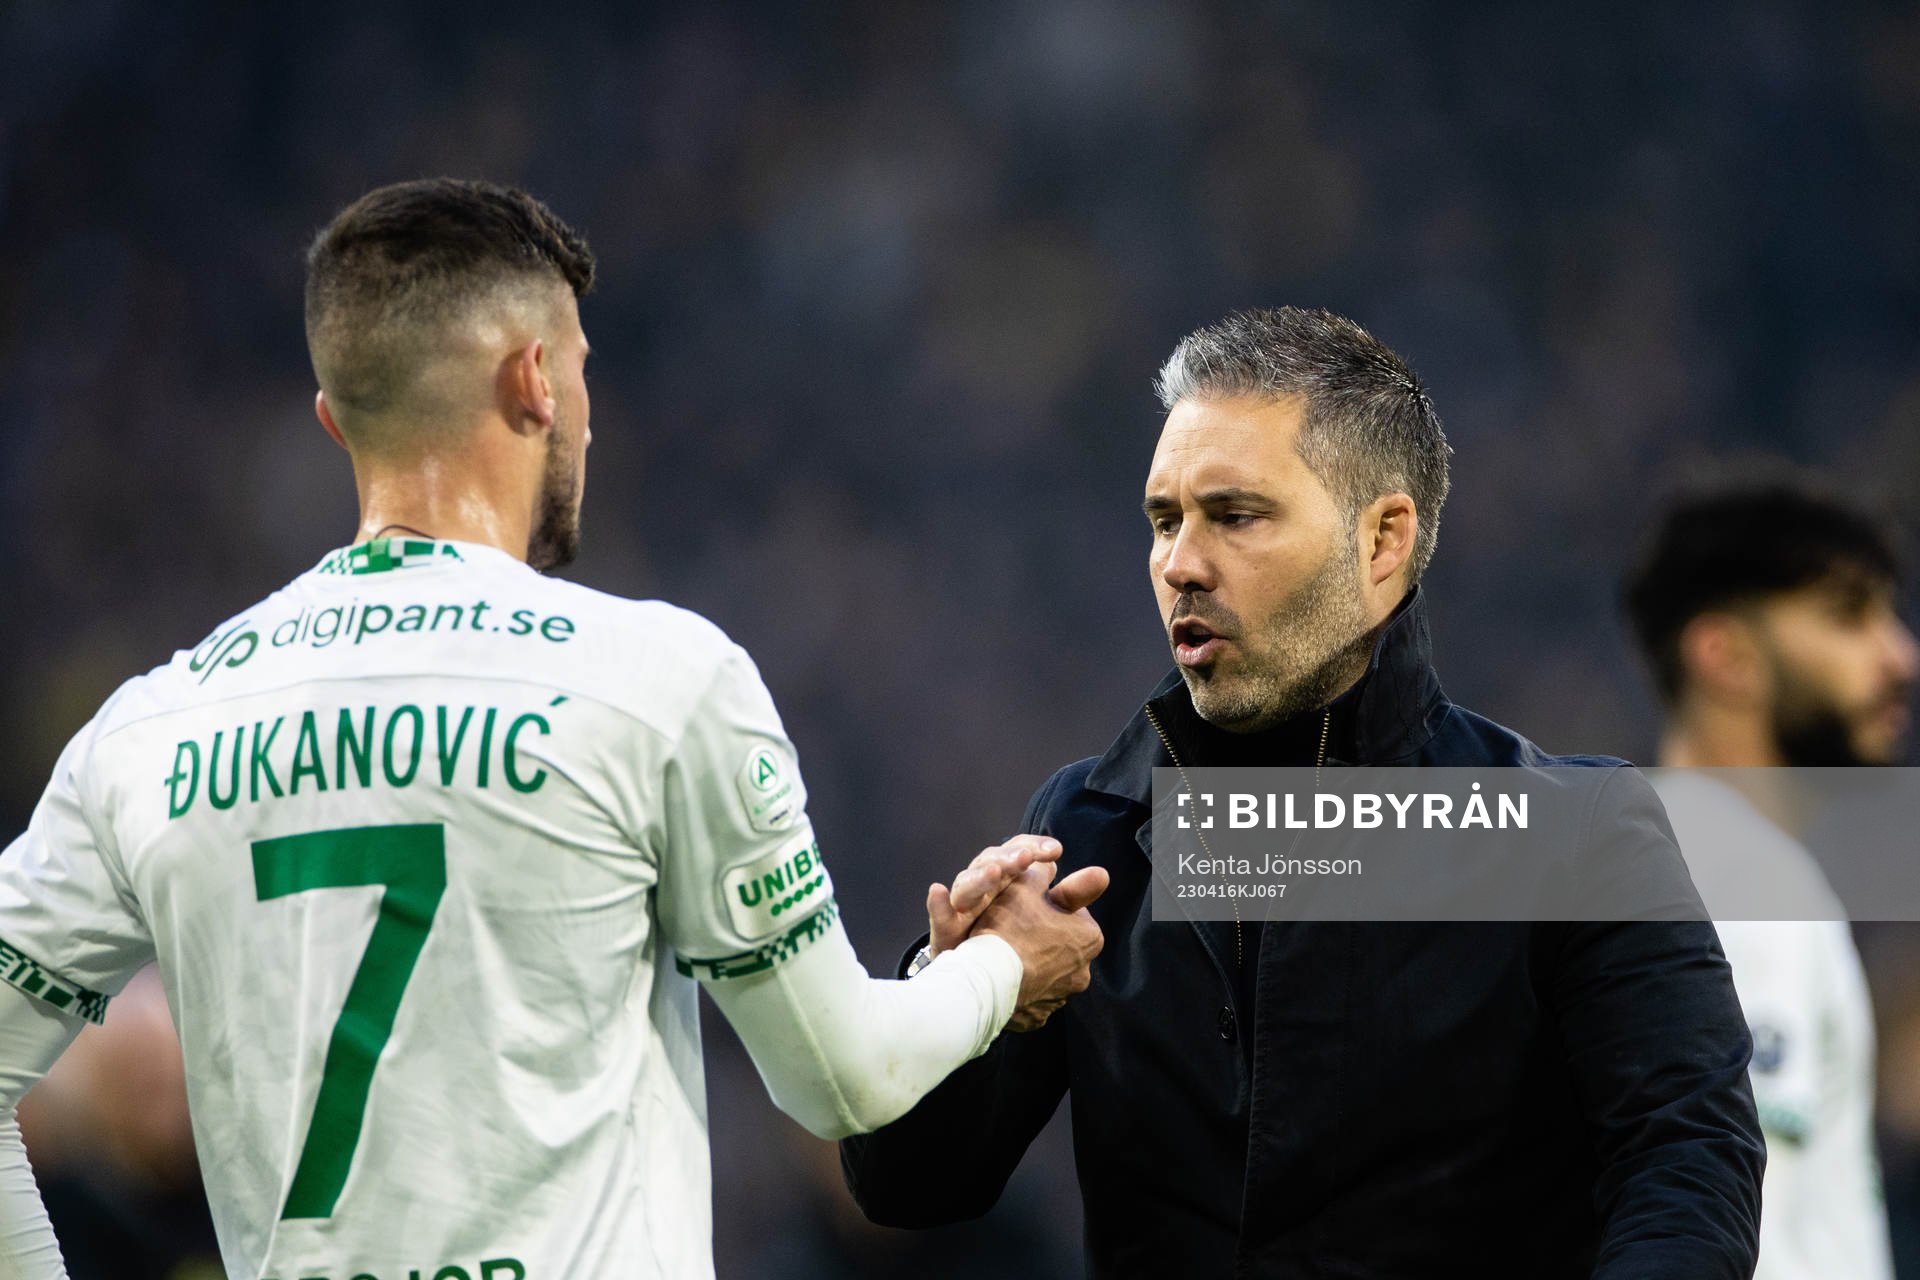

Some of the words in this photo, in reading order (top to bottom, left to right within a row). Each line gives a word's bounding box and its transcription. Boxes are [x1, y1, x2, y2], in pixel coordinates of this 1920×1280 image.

[271, 599, 577, 648] digipant.se
[163, 694, 569, 819] ĐUKANOVIĆ
[250, 822, 449, 1222] 7
